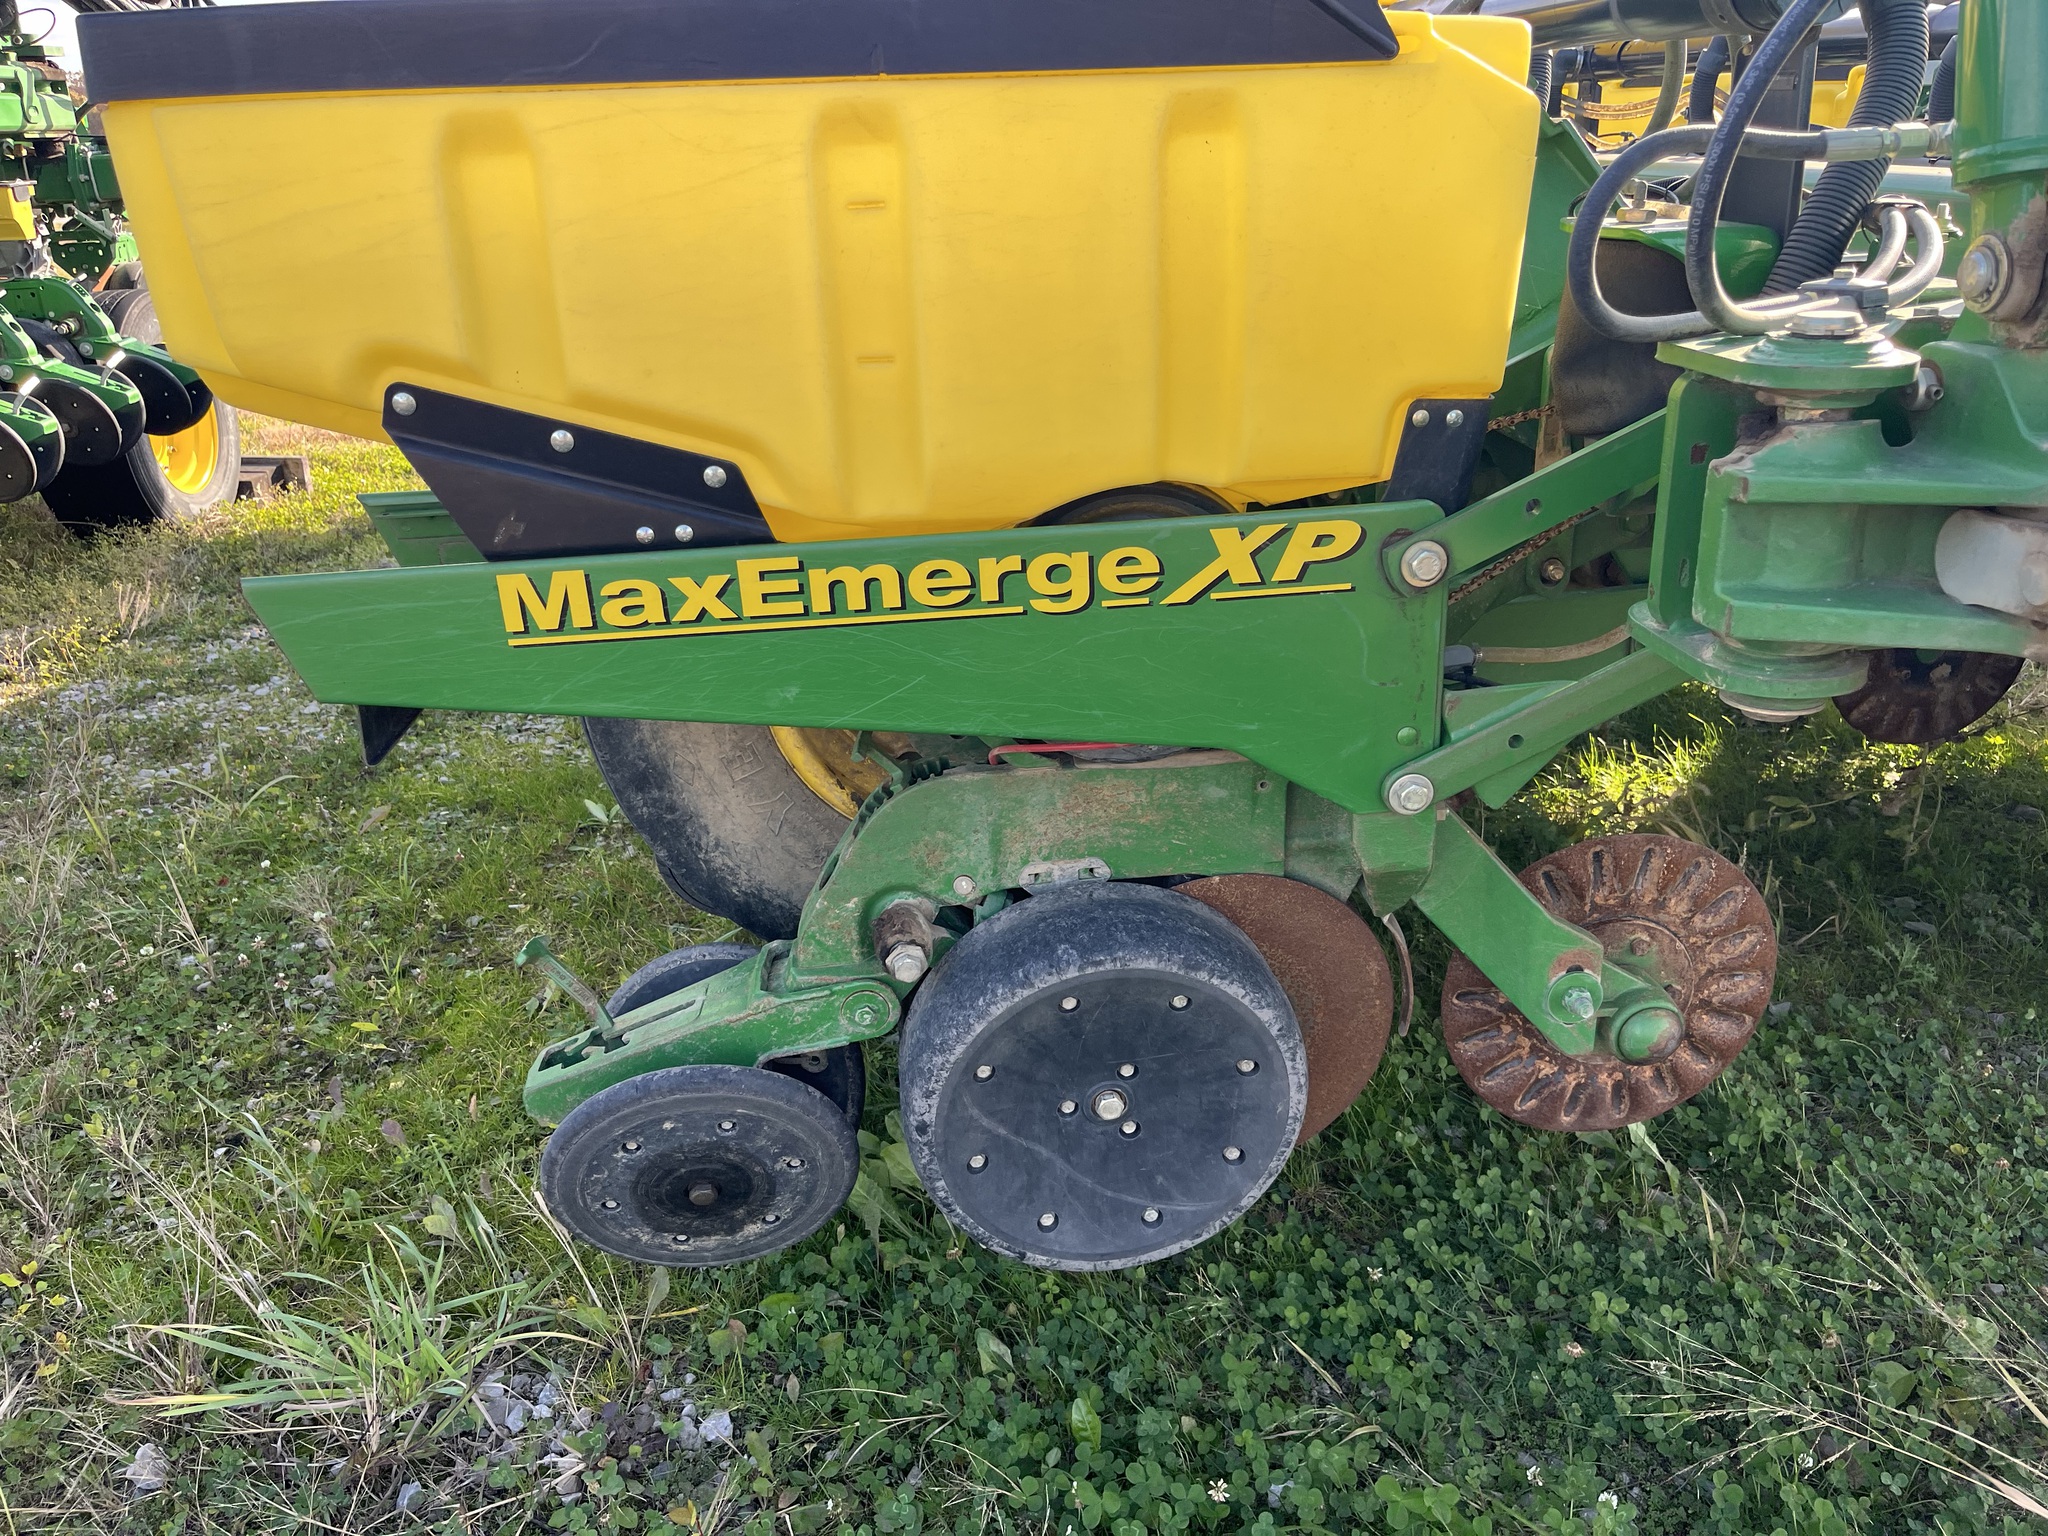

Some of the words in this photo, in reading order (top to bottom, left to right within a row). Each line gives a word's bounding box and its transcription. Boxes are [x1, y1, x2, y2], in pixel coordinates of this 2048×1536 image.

[1706, 140, 1724, 171] 3000
[1699, 172, 1713, 194] PSI
[495, 545, 1162, 634] MaxEmerge
[1159, 519, 1366, 606] XP
